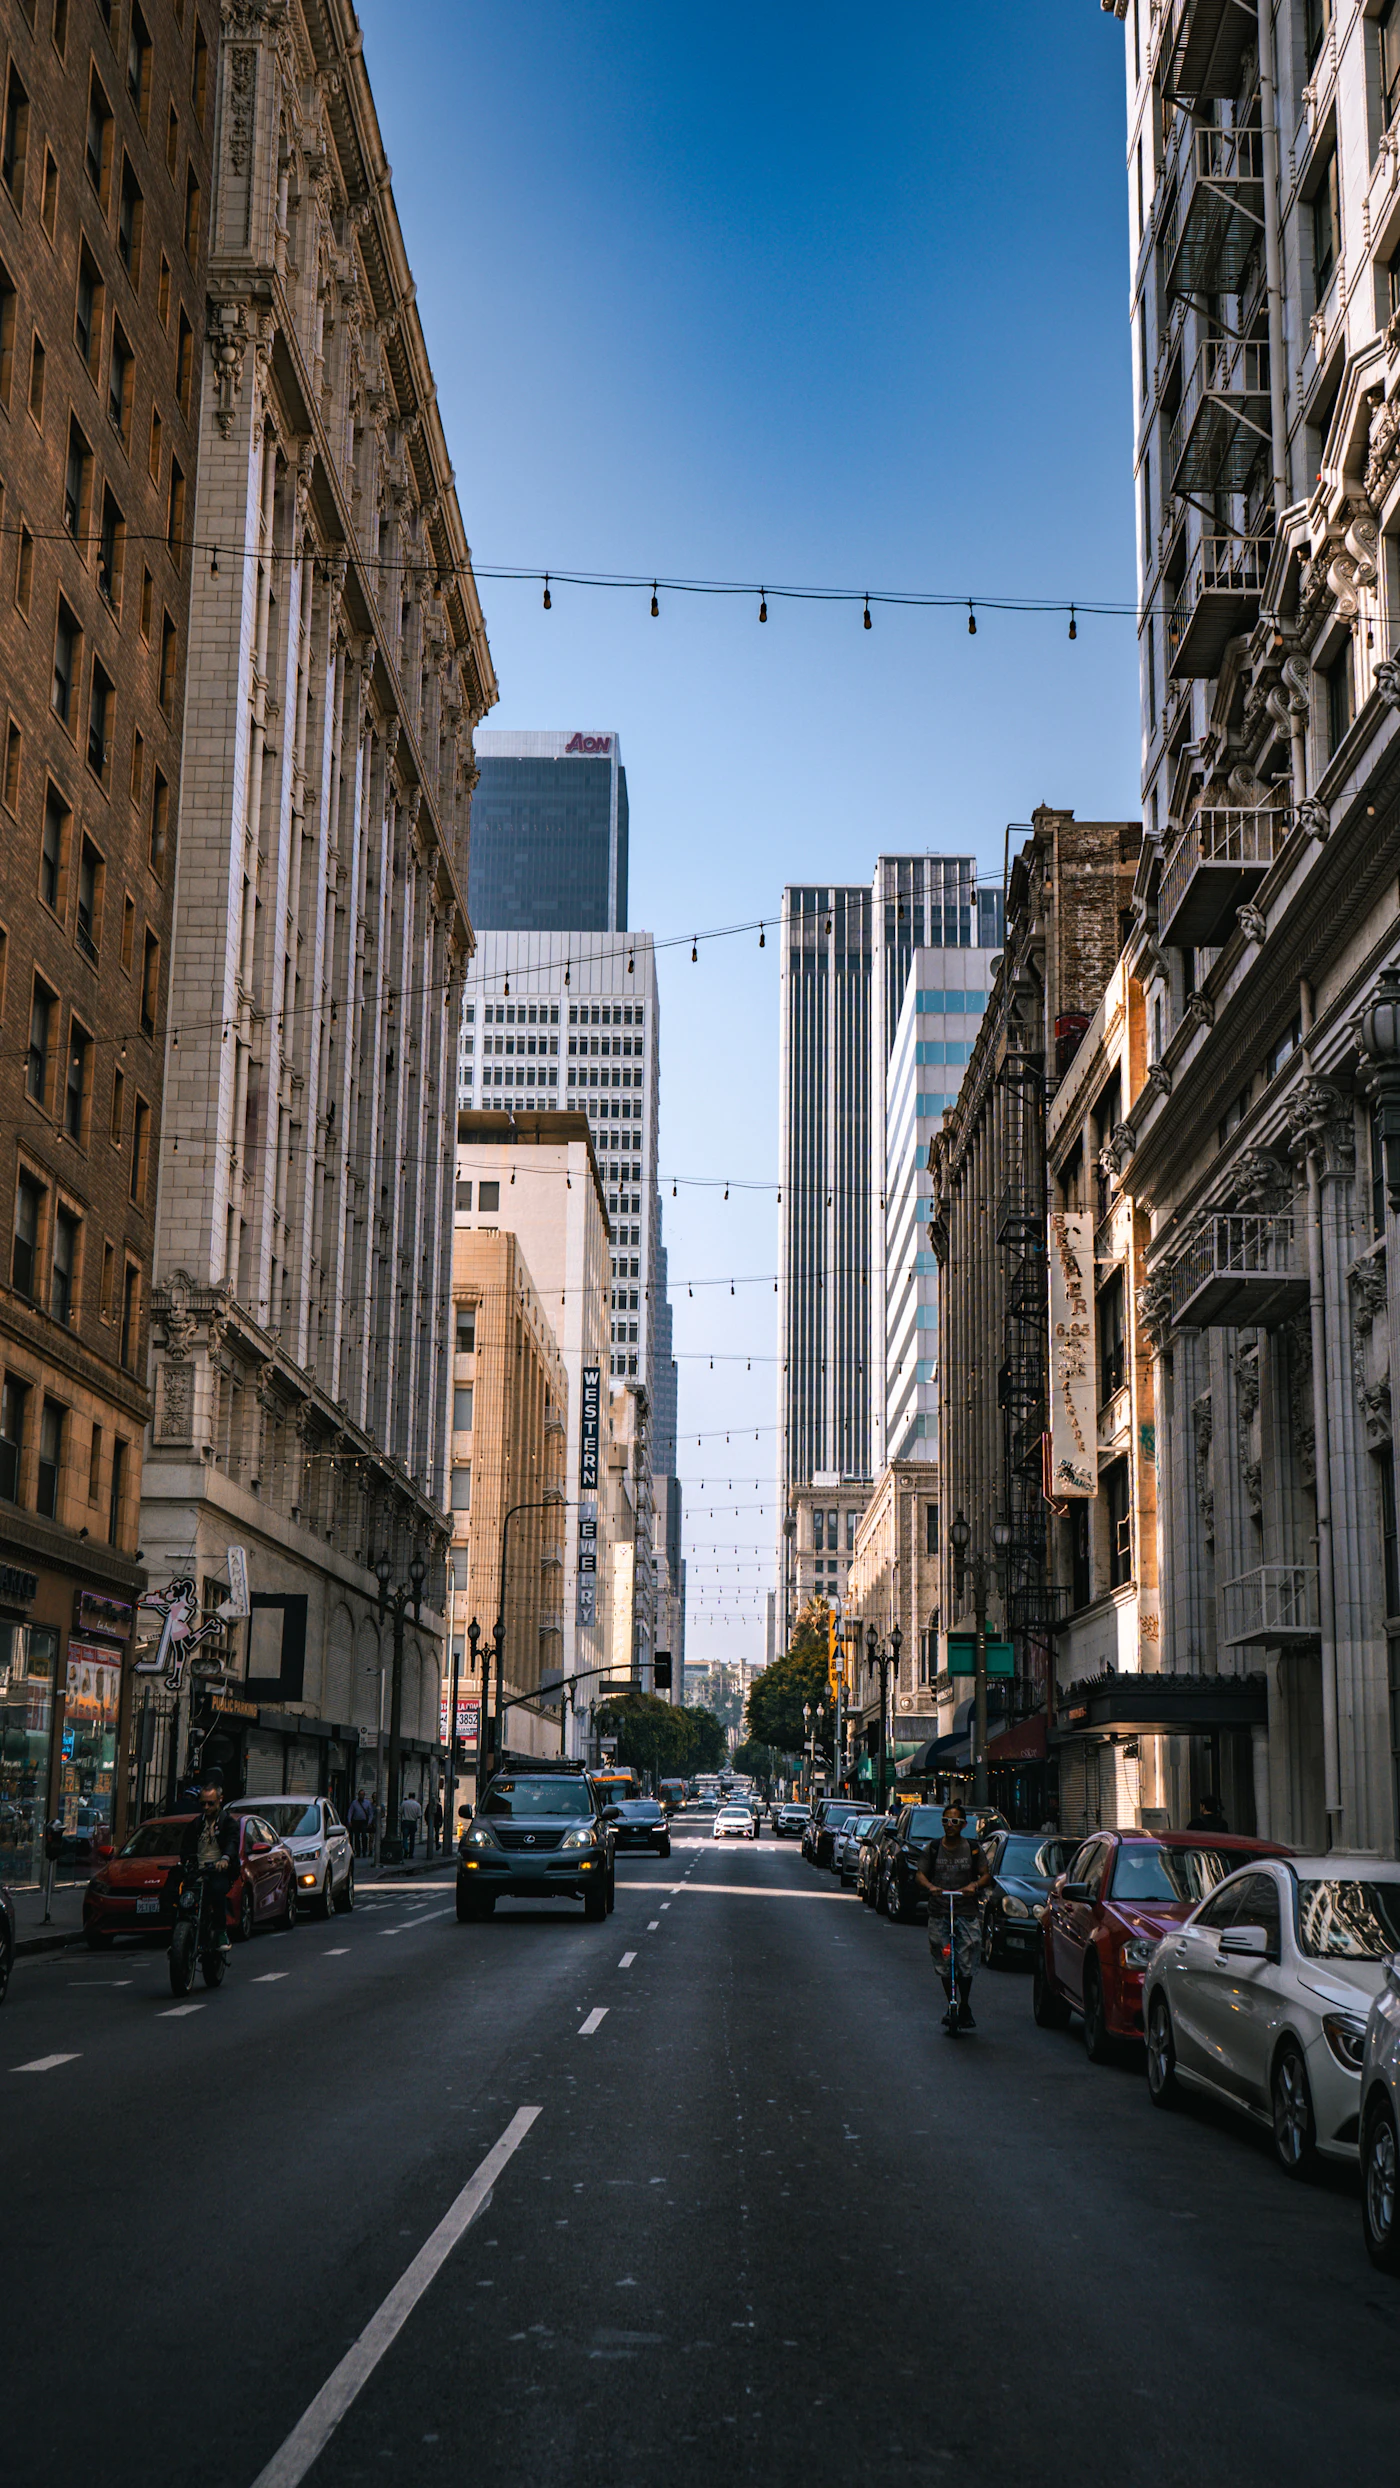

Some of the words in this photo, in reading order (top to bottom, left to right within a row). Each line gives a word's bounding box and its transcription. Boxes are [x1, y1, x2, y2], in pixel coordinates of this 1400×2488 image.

[1056, 1323, 1090, 1337] 6.95
[583, 1371, 599, 1485] WESTERN
[580, 1505, 595, 1621] JEWELRY
[212, 1695, 234, 1713] PUBLIC
[234, 1700, 258, 1717] PARKING
